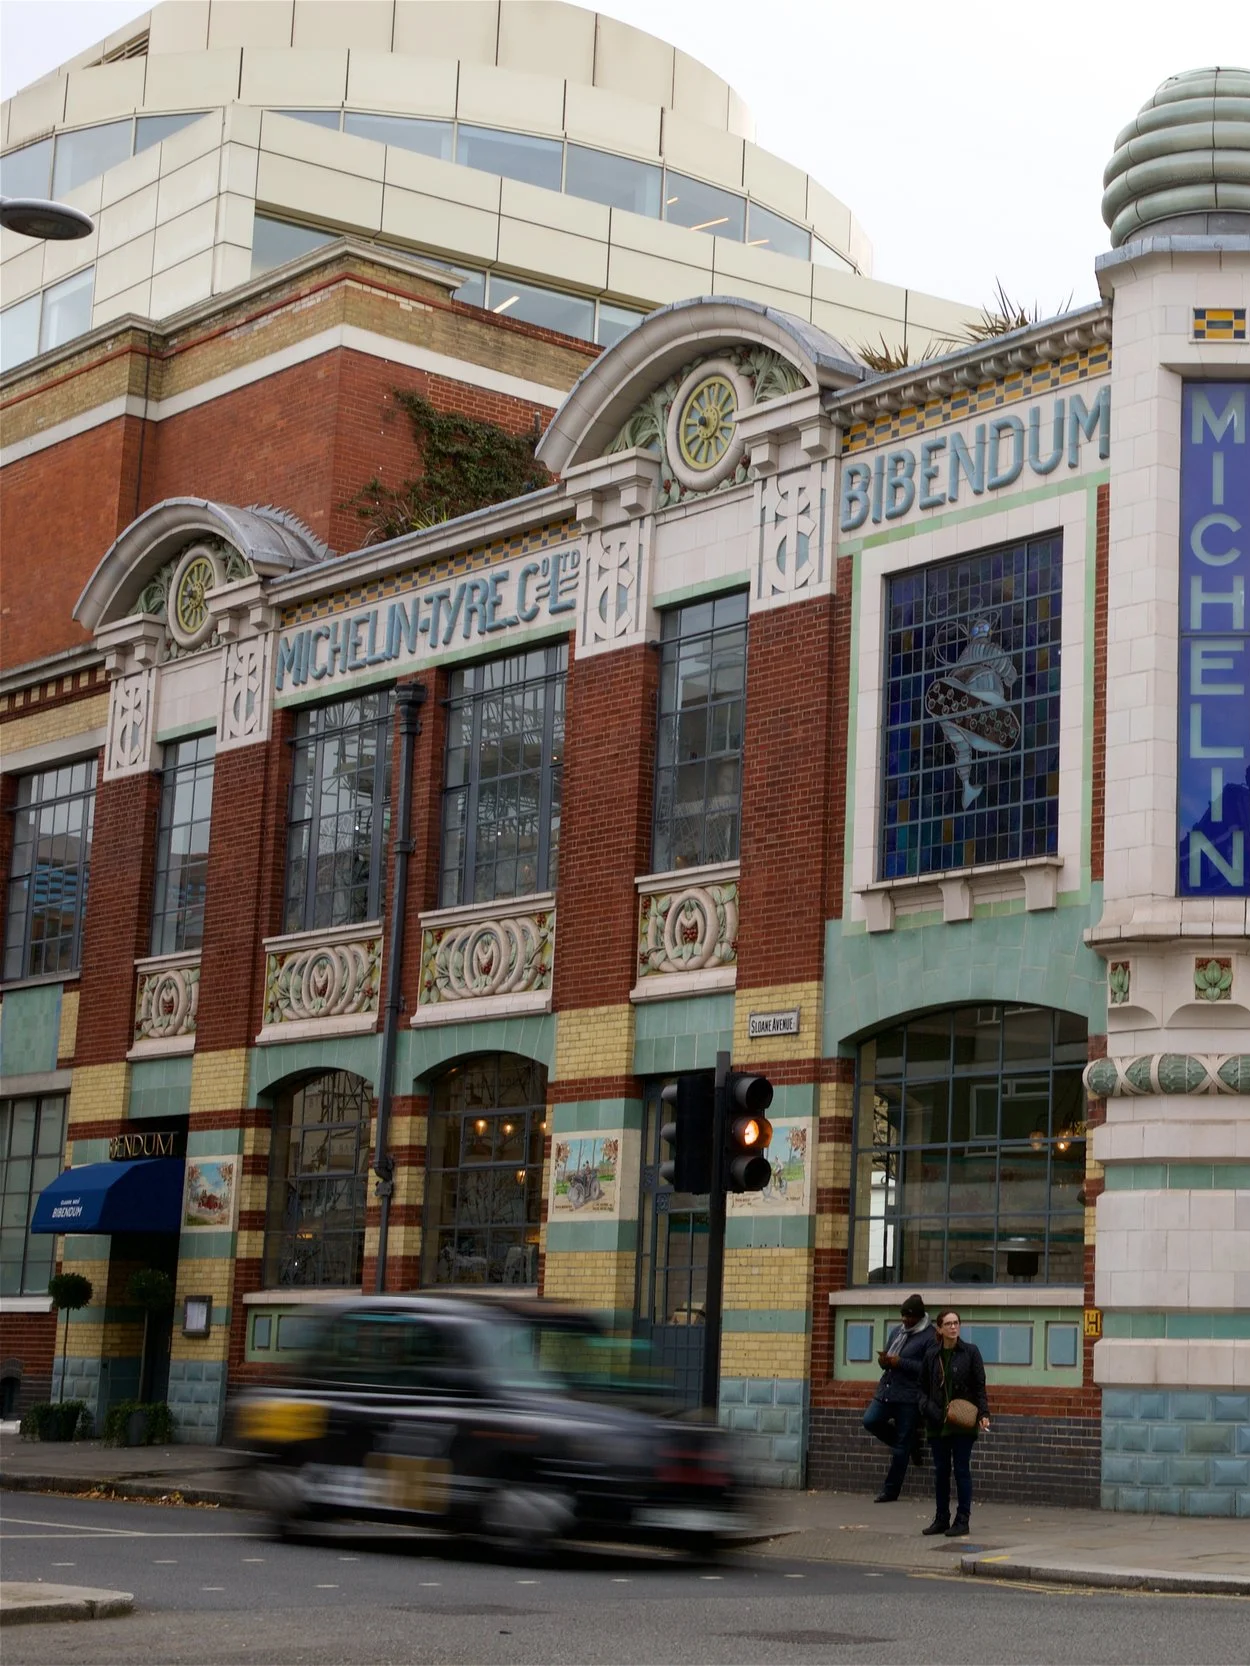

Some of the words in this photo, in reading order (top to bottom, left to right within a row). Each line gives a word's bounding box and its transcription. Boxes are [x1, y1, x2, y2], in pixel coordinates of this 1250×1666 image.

[841, 384, 1111, 532] BIBENDUM
[1190, 390, 1245, 888] MICHELIN
[751, 1019, 772, 1034] SLOANE
[772, 1017, 793, 1032] AVENUE
